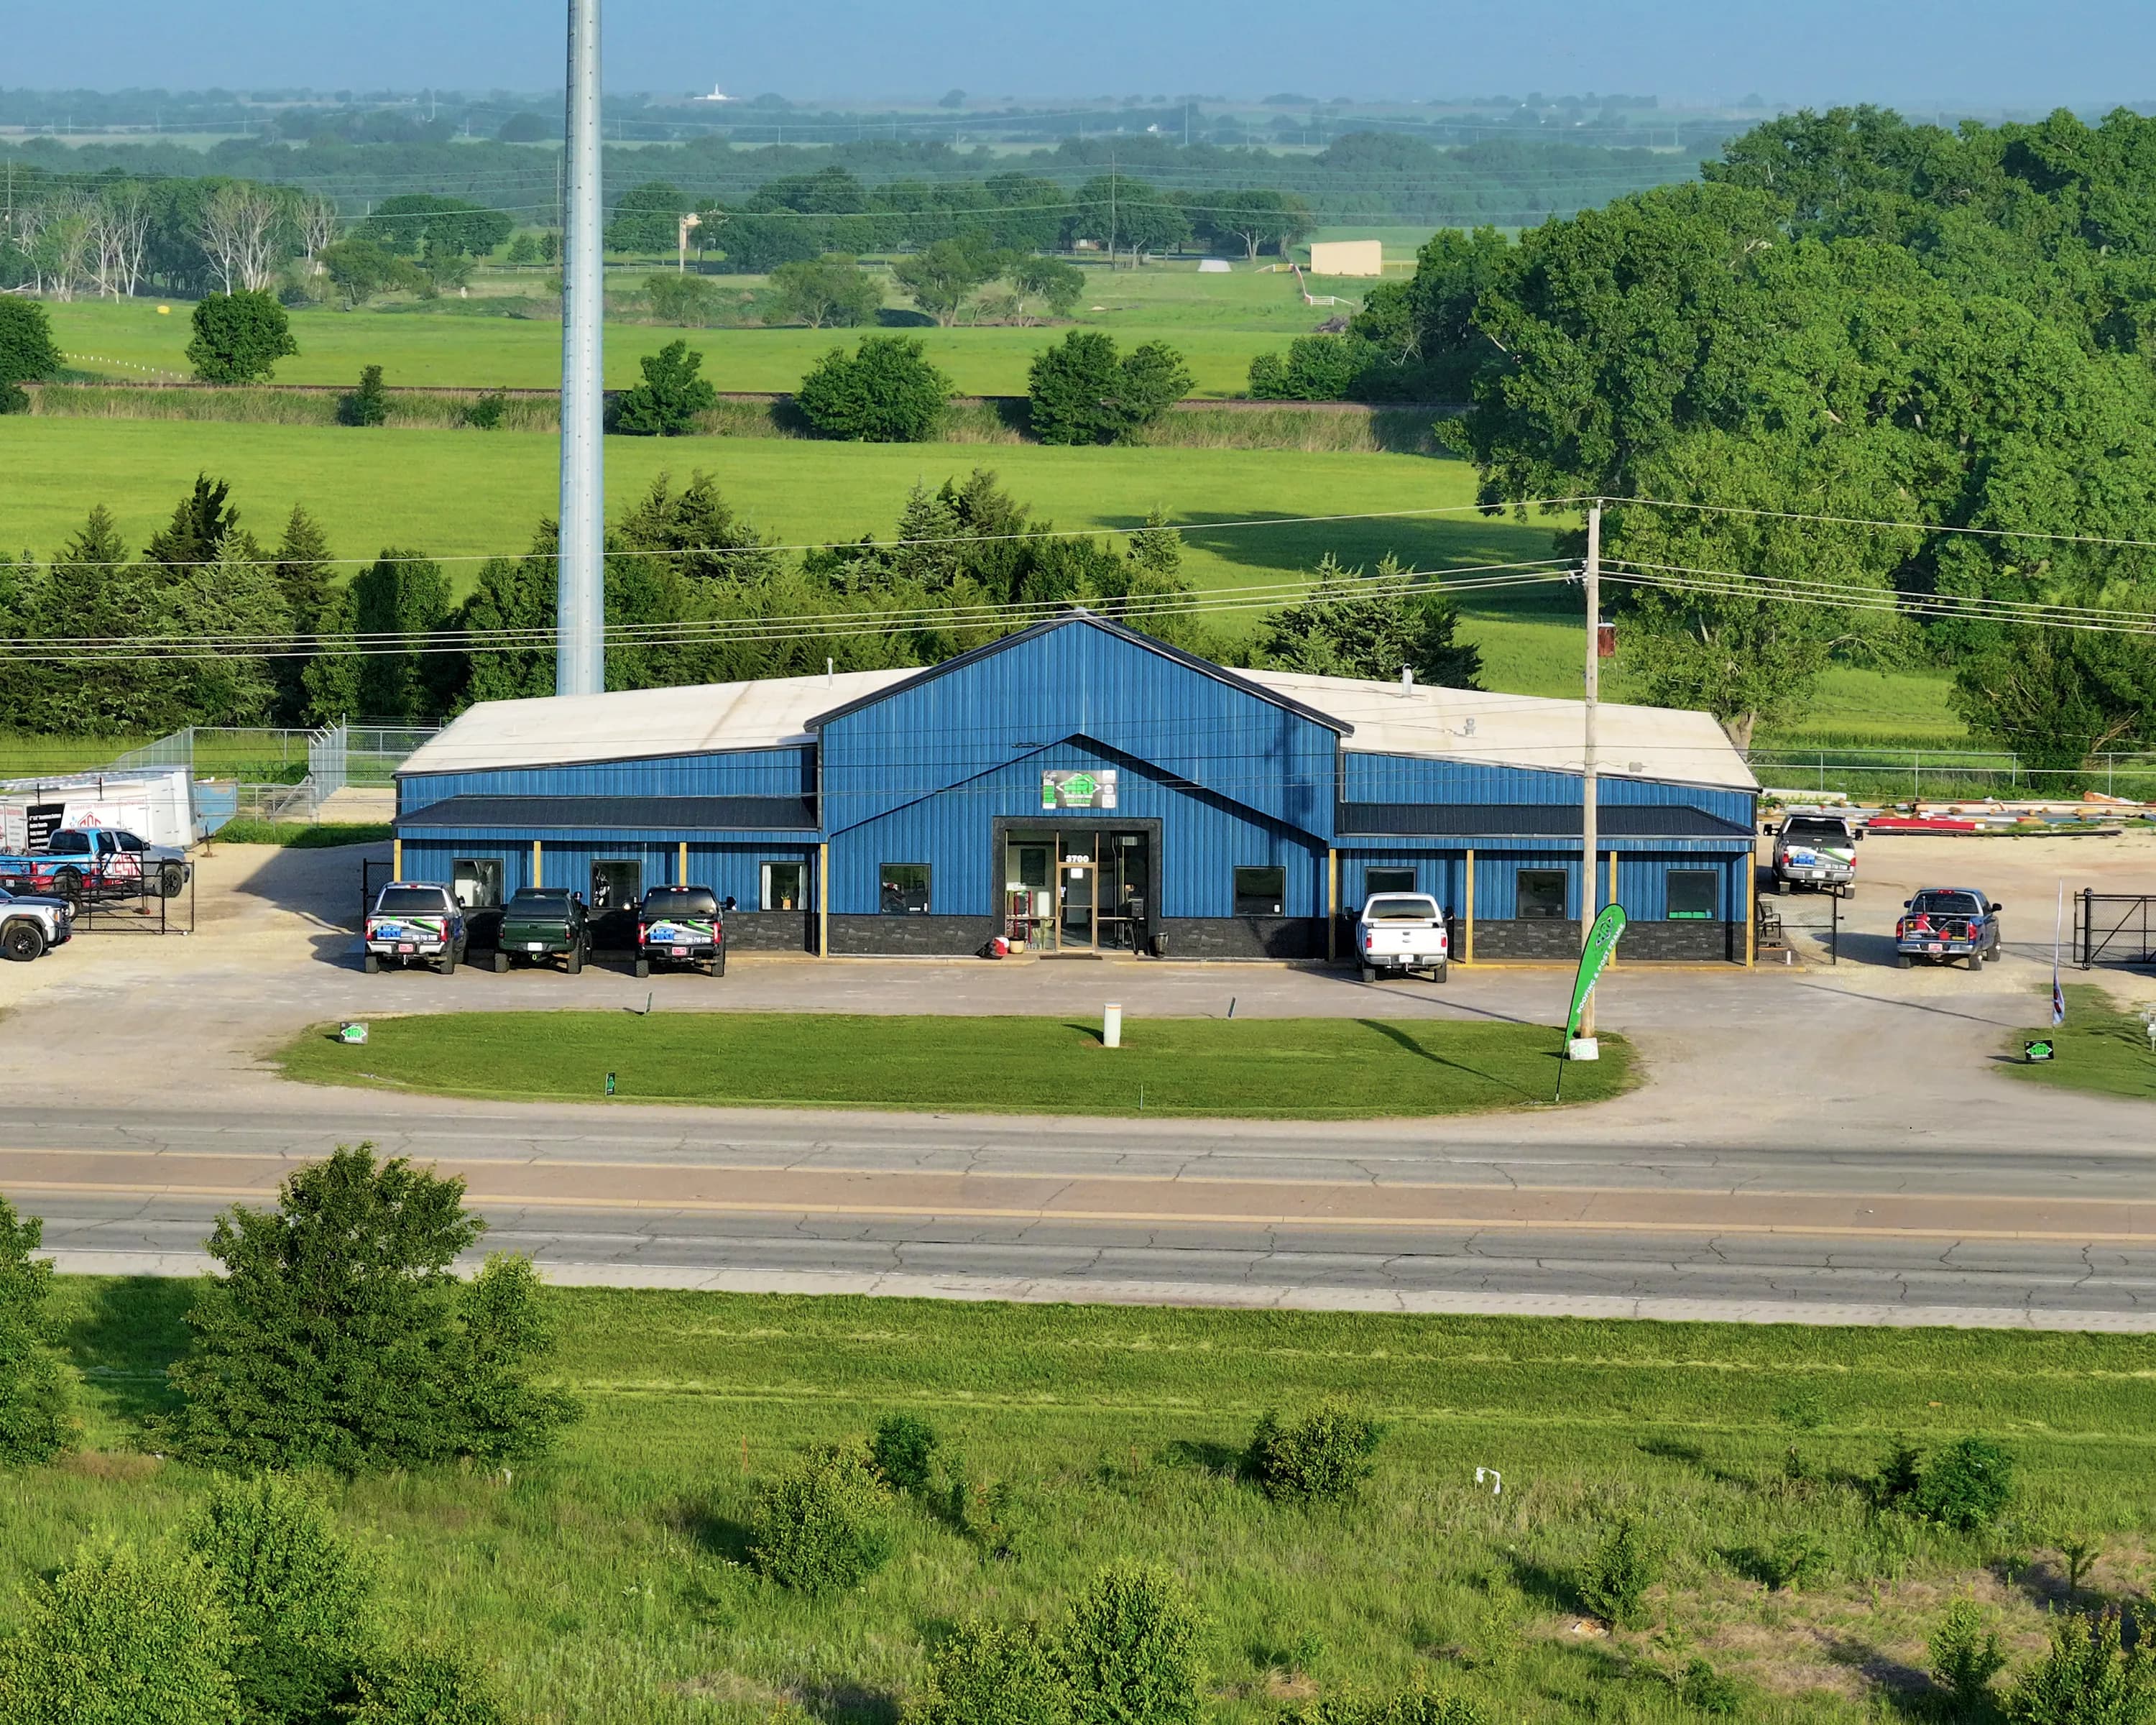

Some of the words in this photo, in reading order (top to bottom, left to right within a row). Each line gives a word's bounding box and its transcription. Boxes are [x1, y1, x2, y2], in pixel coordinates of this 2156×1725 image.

[1577, 979, 1595, 1014] ROOFING
[1598, 950, 1610, 972] POST
[1608, 923, 1626, 949] FRAME
[345, 1029, 362, 1039] HRI
[2031, 1046, 2048, 1055] HRI
